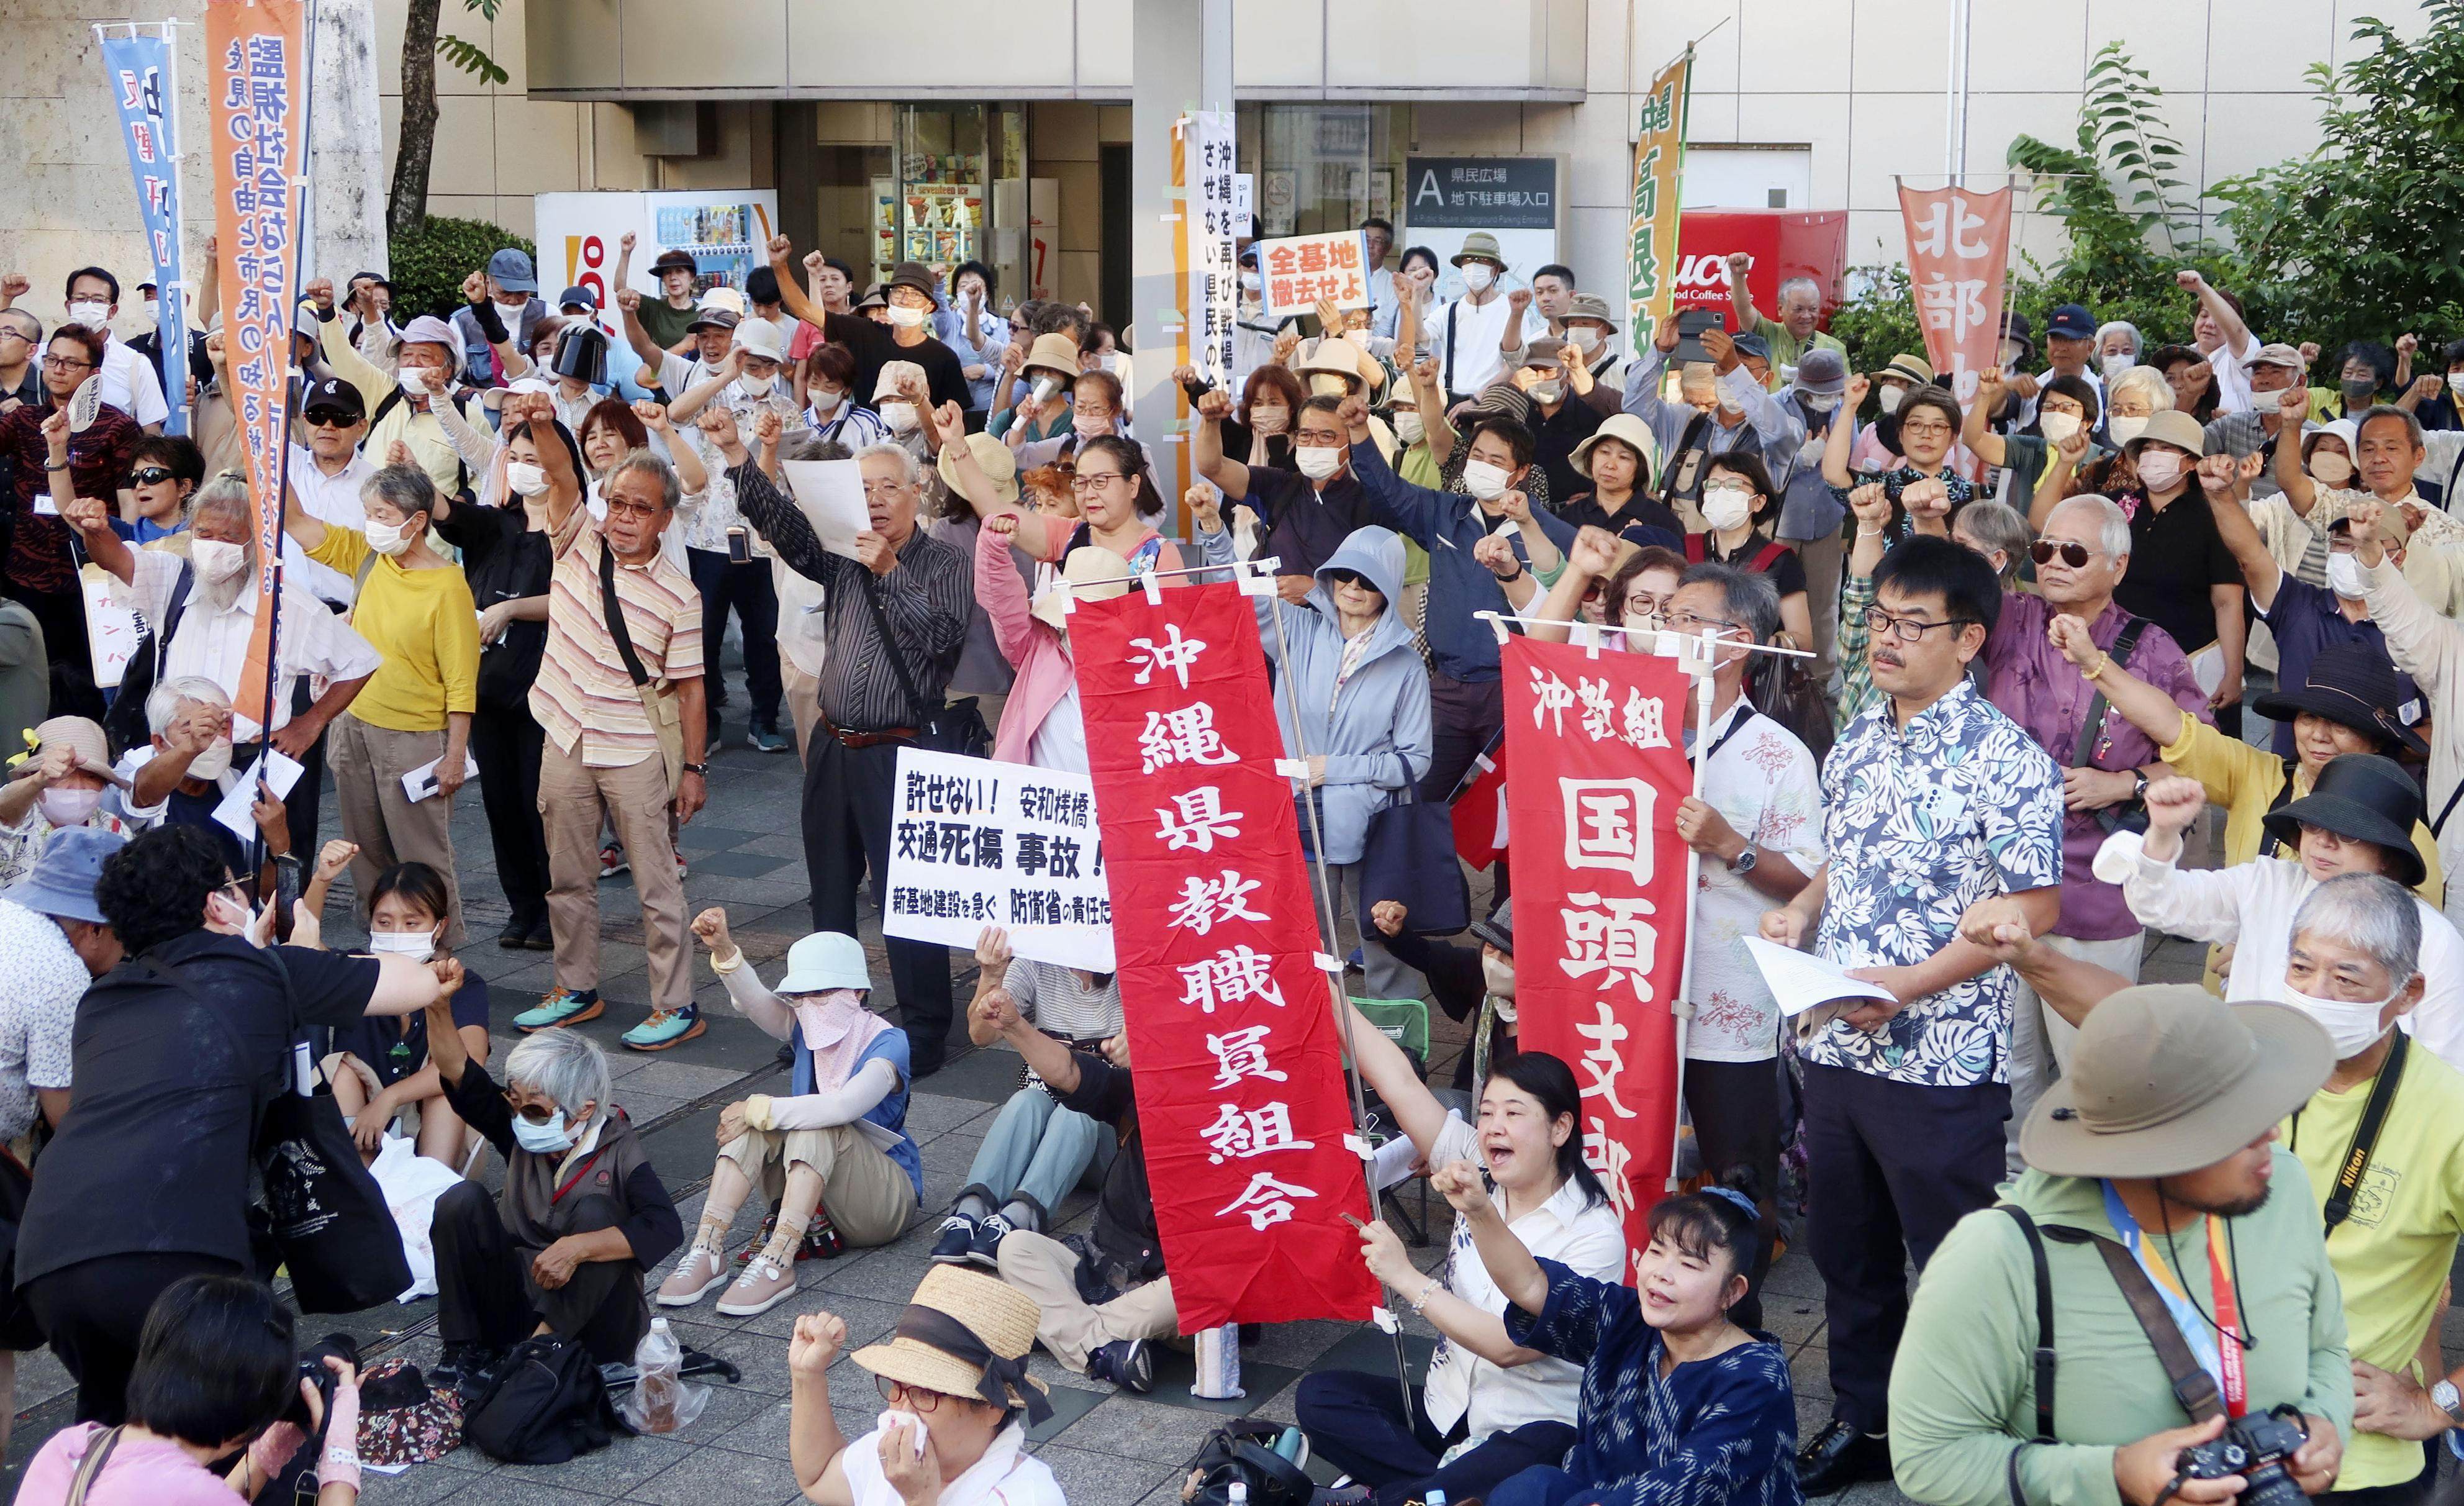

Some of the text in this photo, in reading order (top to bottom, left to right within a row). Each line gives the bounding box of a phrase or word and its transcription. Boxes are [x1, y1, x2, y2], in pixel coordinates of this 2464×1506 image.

[1415, 169, 1444, 206] A
[1451, 168, 1506, 183] 県民広場
[1451, 191, 1549, 206] 地下駐車場入口
[1269, 240, 1358, 275] 全基地
[1271, 273, 1361, 307] 撤去せよ
[1690, 290, 1723, 299] Coffee
[1529, 666, 1672, 750] 沖教組
[897, 819, 1003, 869] 交通死傷
[893, 886, 996, 921] 新基地建設を急ぐ
[1125, 623, 1319, 1232] 沖縄県教職員組合
[1559, 776, 1659, 1227] 国頭支部
[2341, 1148, 2365, 1189] Nikon
